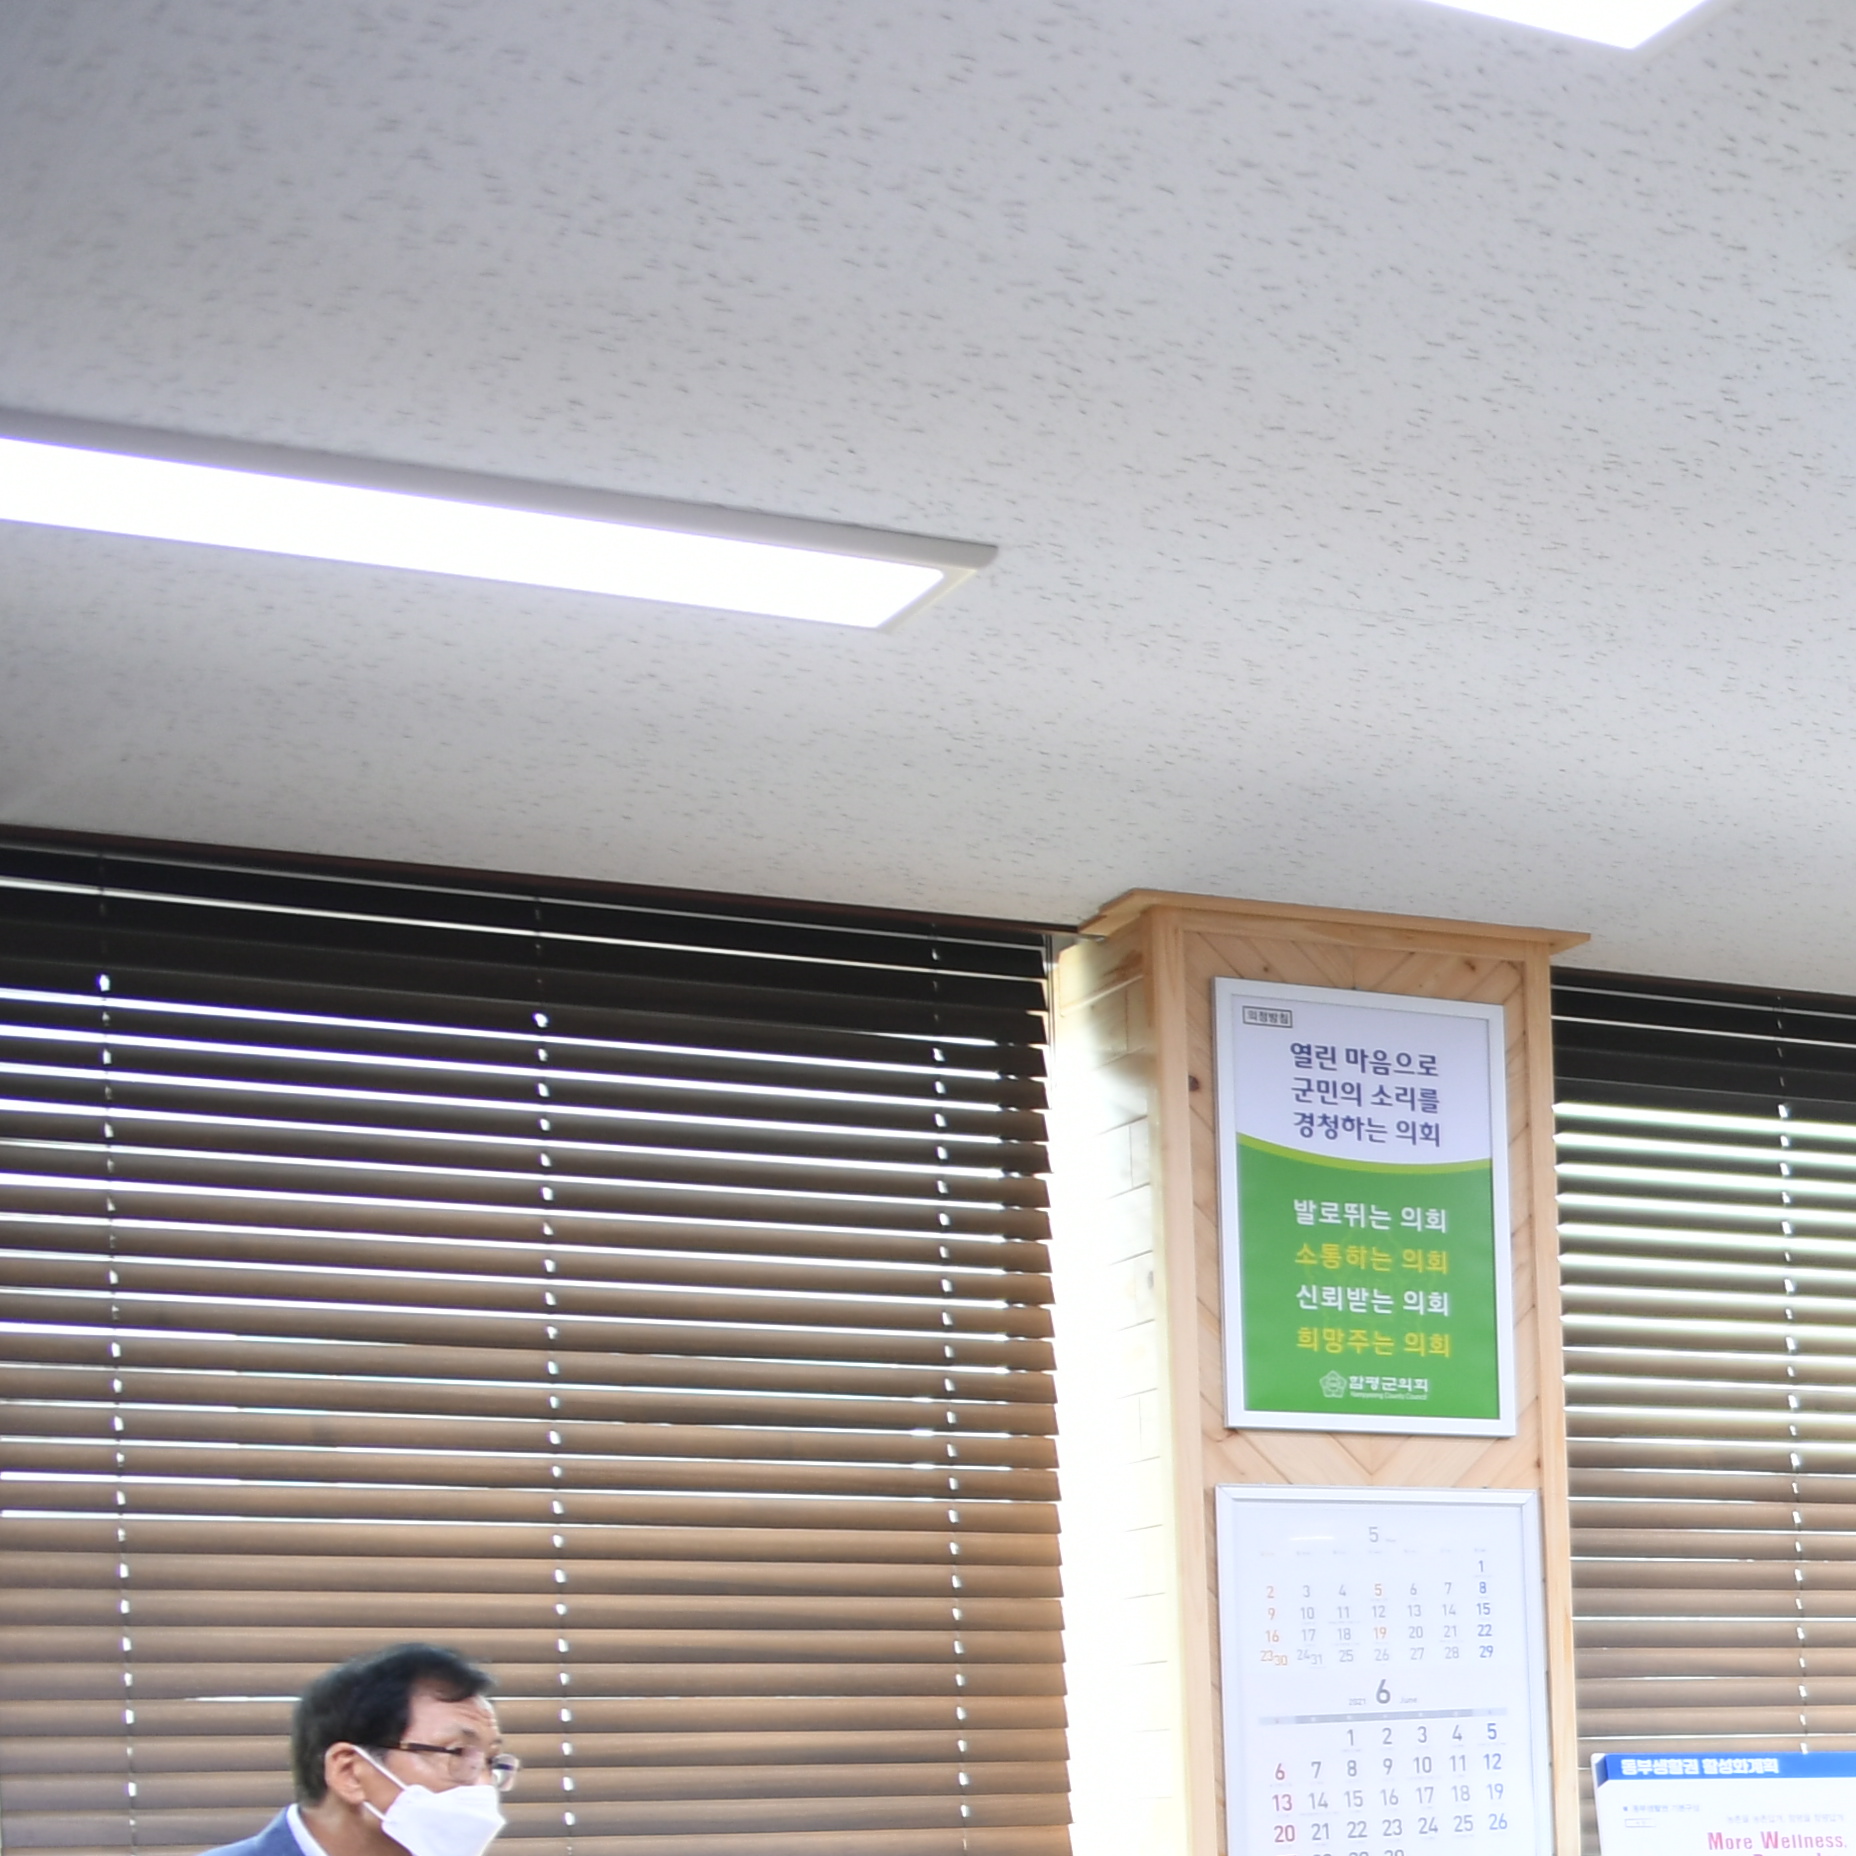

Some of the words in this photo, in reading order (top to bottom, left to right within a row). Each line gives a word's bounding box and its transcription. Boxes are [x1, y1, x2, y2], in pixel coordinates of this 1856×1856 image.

[1290, 1042, 1338, 1071] 열린
[1345, 1048, 1439, 1077] 마음으로
[1291, 1077, 1362, 1107] 군민의
[1371, 1084, 1440, 1114] 소리를
[1293, 1112, 1388, 1143] 경청하는
[1396, 1120, 1440, 1147] 의회
[1294, 1199, 1392, 1230] 발로뛰는
[1400, 1207, 1446, 1234] 의회
[1294, 1243, 1392, 1272] 소통하는
[1402, 1248, 1448, 1274] 의회
[1296, 1284, 1394, 1314] 신뢰받는
[1402, 1290, 1448, 1316] 의회
[1296, 1326, 1394, 1356] 희망주는
[1404, 1332, 1450, 1358] 의회
[1348, 1376, 1428, 1392] 함평군의회
[1369, 1527, 1378, 1542] 5
[1479, 1560, 1483, 1572] 1
[1267, 1586, 1274, 1598] 2
[1303, 1585, 1310, 1598] 3
[1339, 1585, 1346, 1596] 4
[1375, 1584, 1382, 1596] 5
[1410, 1583, 1417, 1595] 6
[1445, 1582, 1452, 1594] 7
[1480, 1582, 1486, 1594] 8
[1268, 1608, 1275, 1620] 9
[1301, 1607, 1315, 1619] 10
[1337, 1606, 1349, 1619] 11
[1372, 1605, 1386, 1618] 12
[1408, 1604, 1421, 1617] 13
[1442, 1604, 1456, 1616] 14
[1477, 1603, 1490, 1615] 15
[1265, 1630, 1279, 1642] 16
[1302, 1629, 1316, 1641] 17
[1338, 1628, 1351, 1640] 18
[1374, 1627, 1387, 1639] 19
[1409, 1626, 1423, 1639] 20
[1444, 1625, 1456, 1638] 21
[1478, 1624, 1492, 1637] 22
[1260, 1650, 1275, 1661] 23
[1273, 1655, 1288, 1666] 30
[1297, 1649, 1312, 1660] 24
[1309, 1654, 1322, 1665] 31
[1339, 1649, 1353, 1662] 25
[1374, 1649, 1389, 1661] 26
[1410, 1647, 1424, 1660] 27
[1445, 1646, 1459, 1659] 28
[1479, 1645, 1493, 1658] 29
[1376, 1679, 1390, 1704] 6
[1347, 1729, 1353, 1746] 1
[1382, 1728, 1392, 1744] 2
[1418, 1726, 1427, 1743] 3
[1452, 1725, 1462, 1741] 4
[1487, 1723, 1497, 1740] 5
[1275, 1763, 1285, 1780] 6
[1311, 1761, 1321, 1778] 7
[1347, 1760, 1357, 1777] 8
[1383, 1758, 1392, 1775] 9
[1413, 1756, 1432, 1773] 10
[1450, 1755, 1465, 1771] 11
[1484, 1753, 1501, 1769] 12
[1622, 1759, 1698, 1774] 동부생활권
[1703, 1758, 1778, 1774] 활성화계획
[1272, 1794, 1292, 1811] 13
[1309, 1792, 1328, 1809] 14
[1344, 1790, 1363, 1807] 15
[1380, 1789, 1399, 1806] 16
[1416, 1786, 1434, 1804] 17
[1452, 1785, 1470, 1802] 18
[1487, 1783, 1503, 1800] 19
[1274, 1825, 1295, 1842] 20
[1311, 1823, 1329, 1840] 21
[1347, 1821, 1367, 1838] 22
[1382, 1819, 1402, 1836] 23
[1418, 1817, 1438, 1834] 24
[1454, 1815, 1473, 1832] 25
[1489, 1813, 1507, 1830] 26
[1708, 1832, 1752, 1850] More
